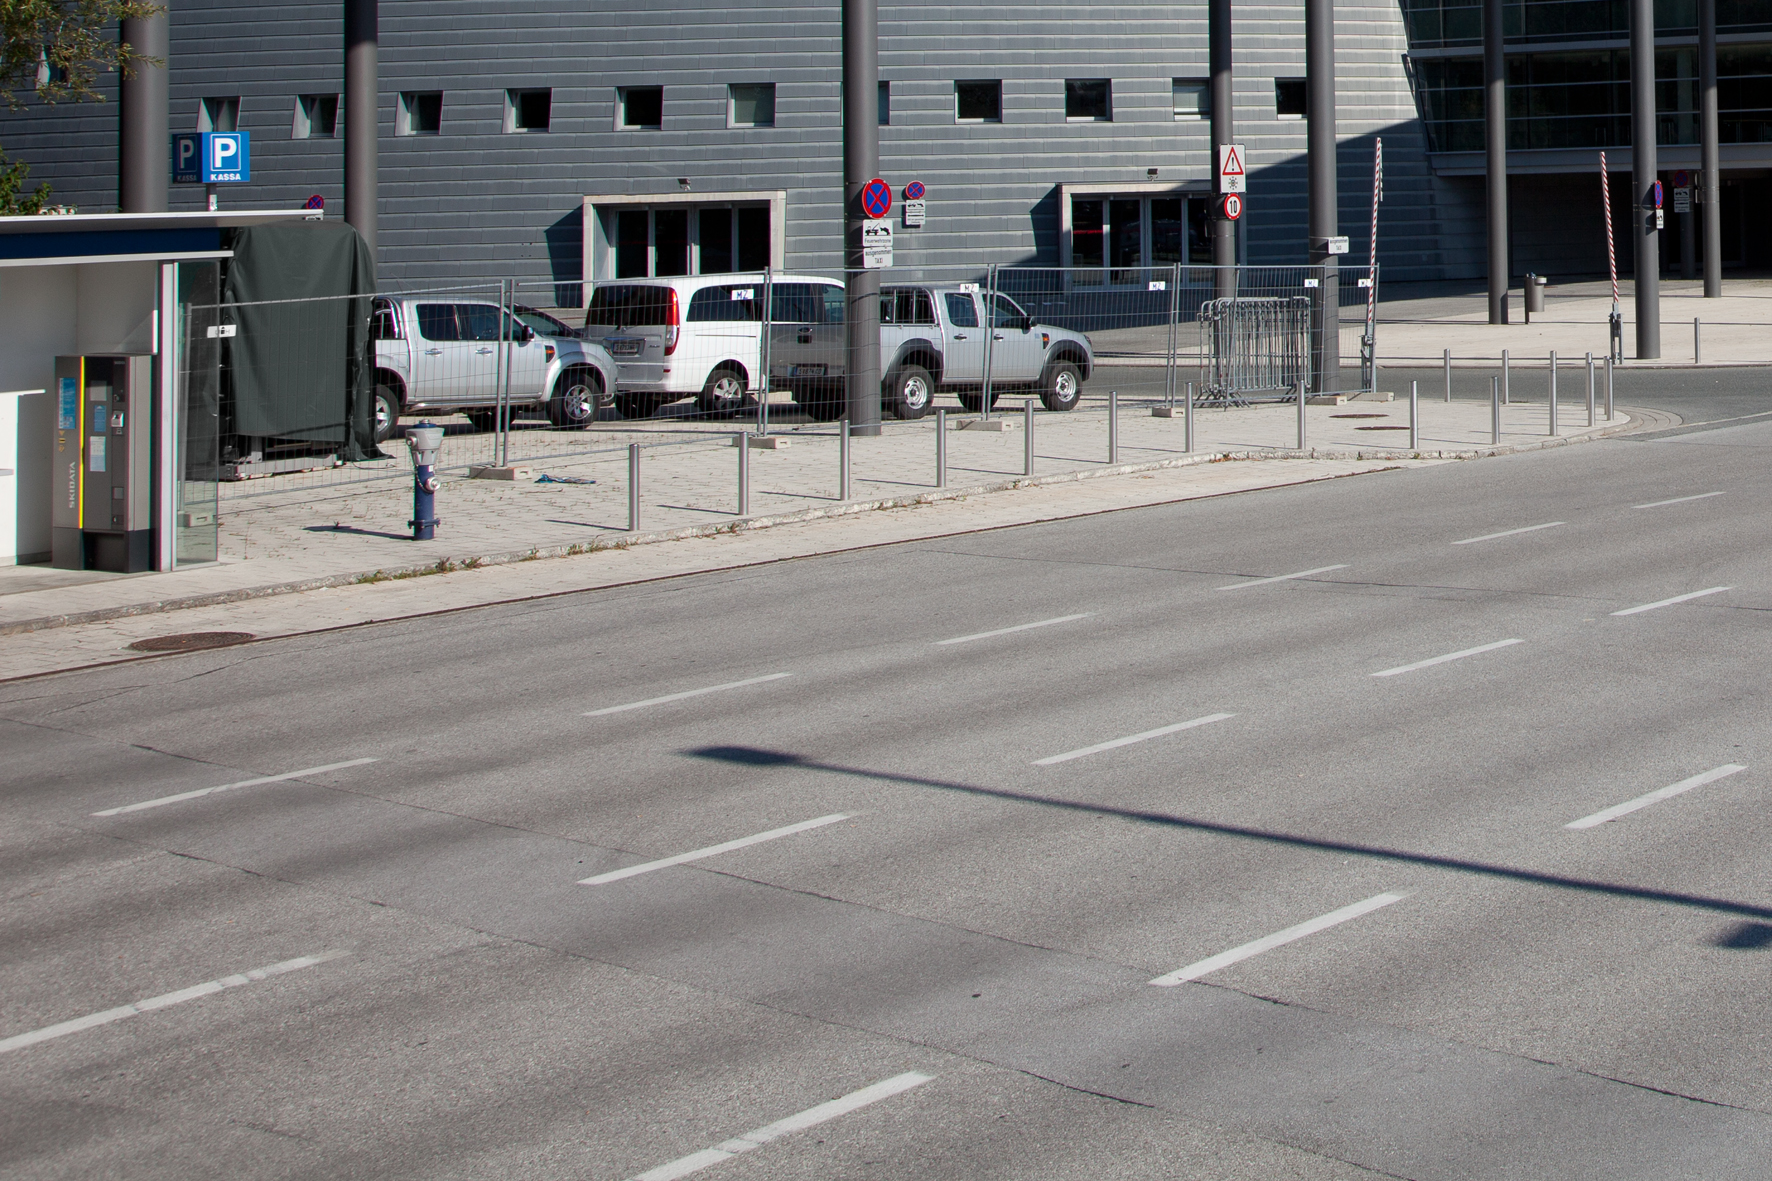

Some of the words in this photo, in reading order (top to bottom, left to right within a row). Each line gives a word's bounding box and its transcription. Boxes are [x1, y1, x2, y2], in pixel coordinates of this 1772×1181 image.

[214, 137, 237, 168] P
[210, 173, 241, 181] KASSA
[1229, 199, 1238, 214] 10
[68, 461, 76, 509] SKIDATA
